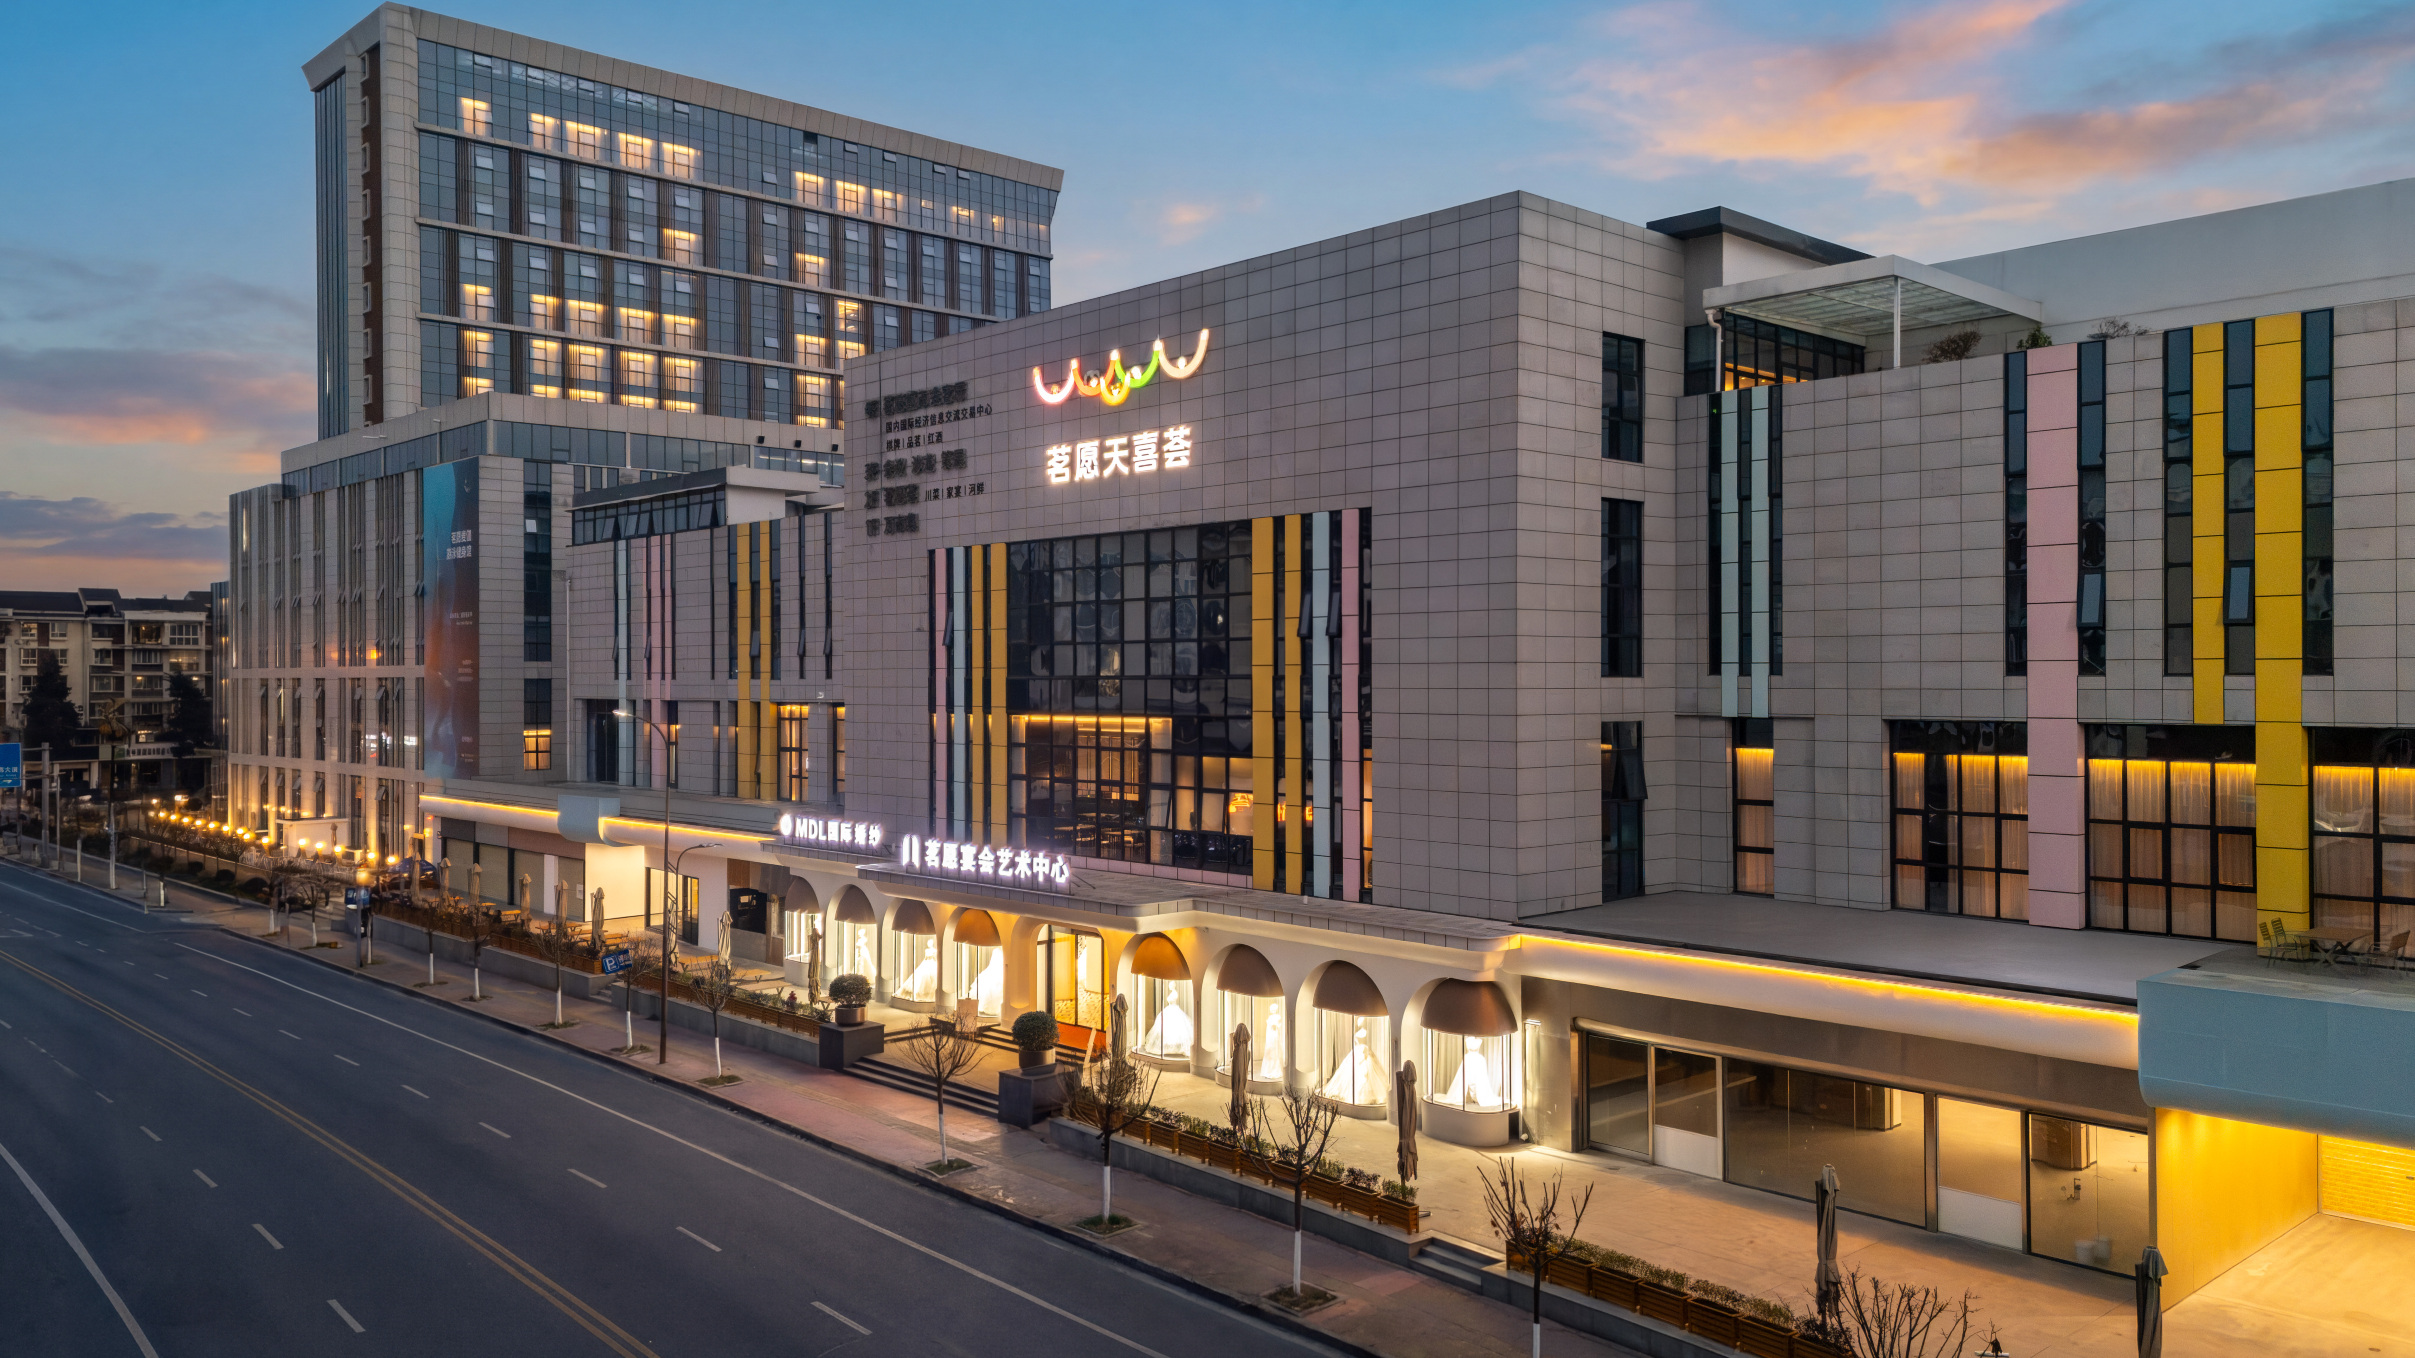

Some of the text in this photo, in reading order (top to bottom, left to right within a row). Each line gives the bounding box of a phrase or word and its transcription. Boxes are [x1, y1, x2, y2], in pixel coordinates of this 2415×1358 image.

[1045, 425, 1192, 485] 茗愿天喜荟
[924, 838, 1070, 884] 茗愿宴会艺术中心
